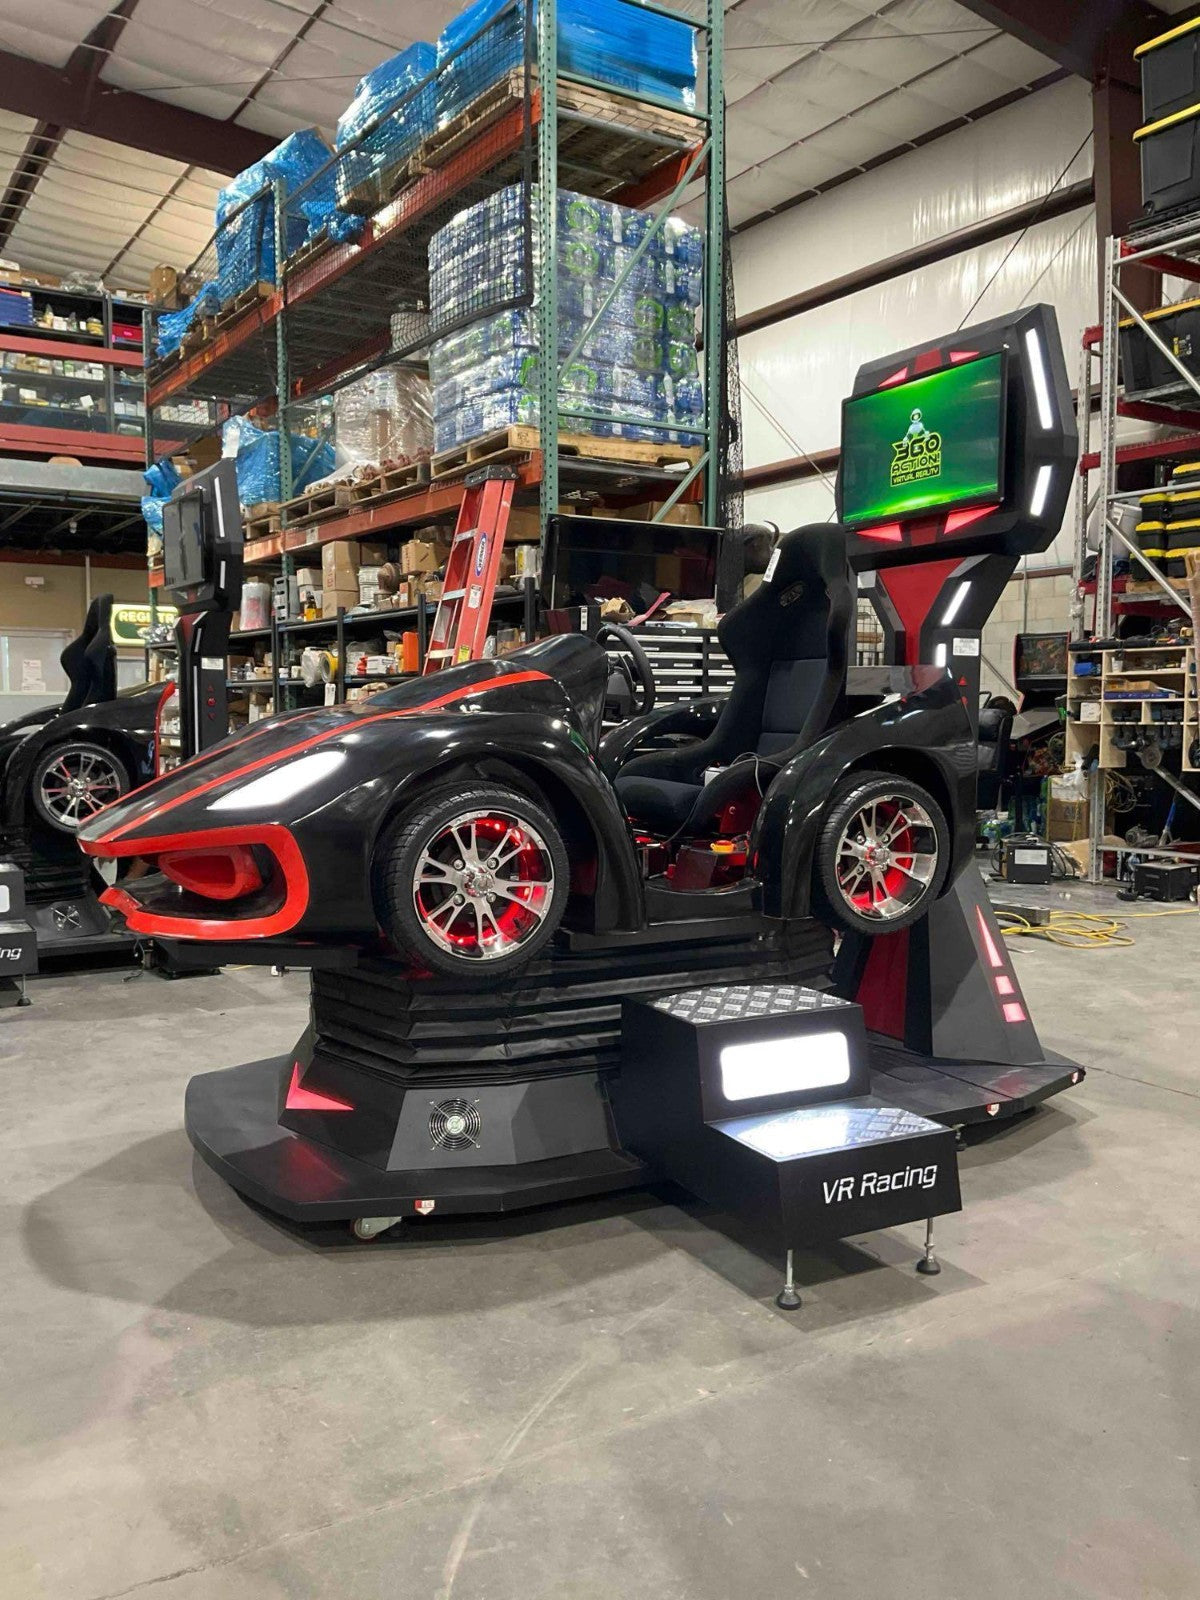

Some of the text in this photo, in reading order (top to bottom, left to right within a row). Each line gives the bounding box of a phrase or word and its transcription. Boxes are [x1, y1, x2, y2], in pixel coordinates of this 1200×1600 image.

[893, 433, 940, 462] 360
[893, 467, 938, 483] VIRTUAL REALITY
[118, 610, 177, 624] REGITR
[822, 1164, 938, 1205] VR Racing
